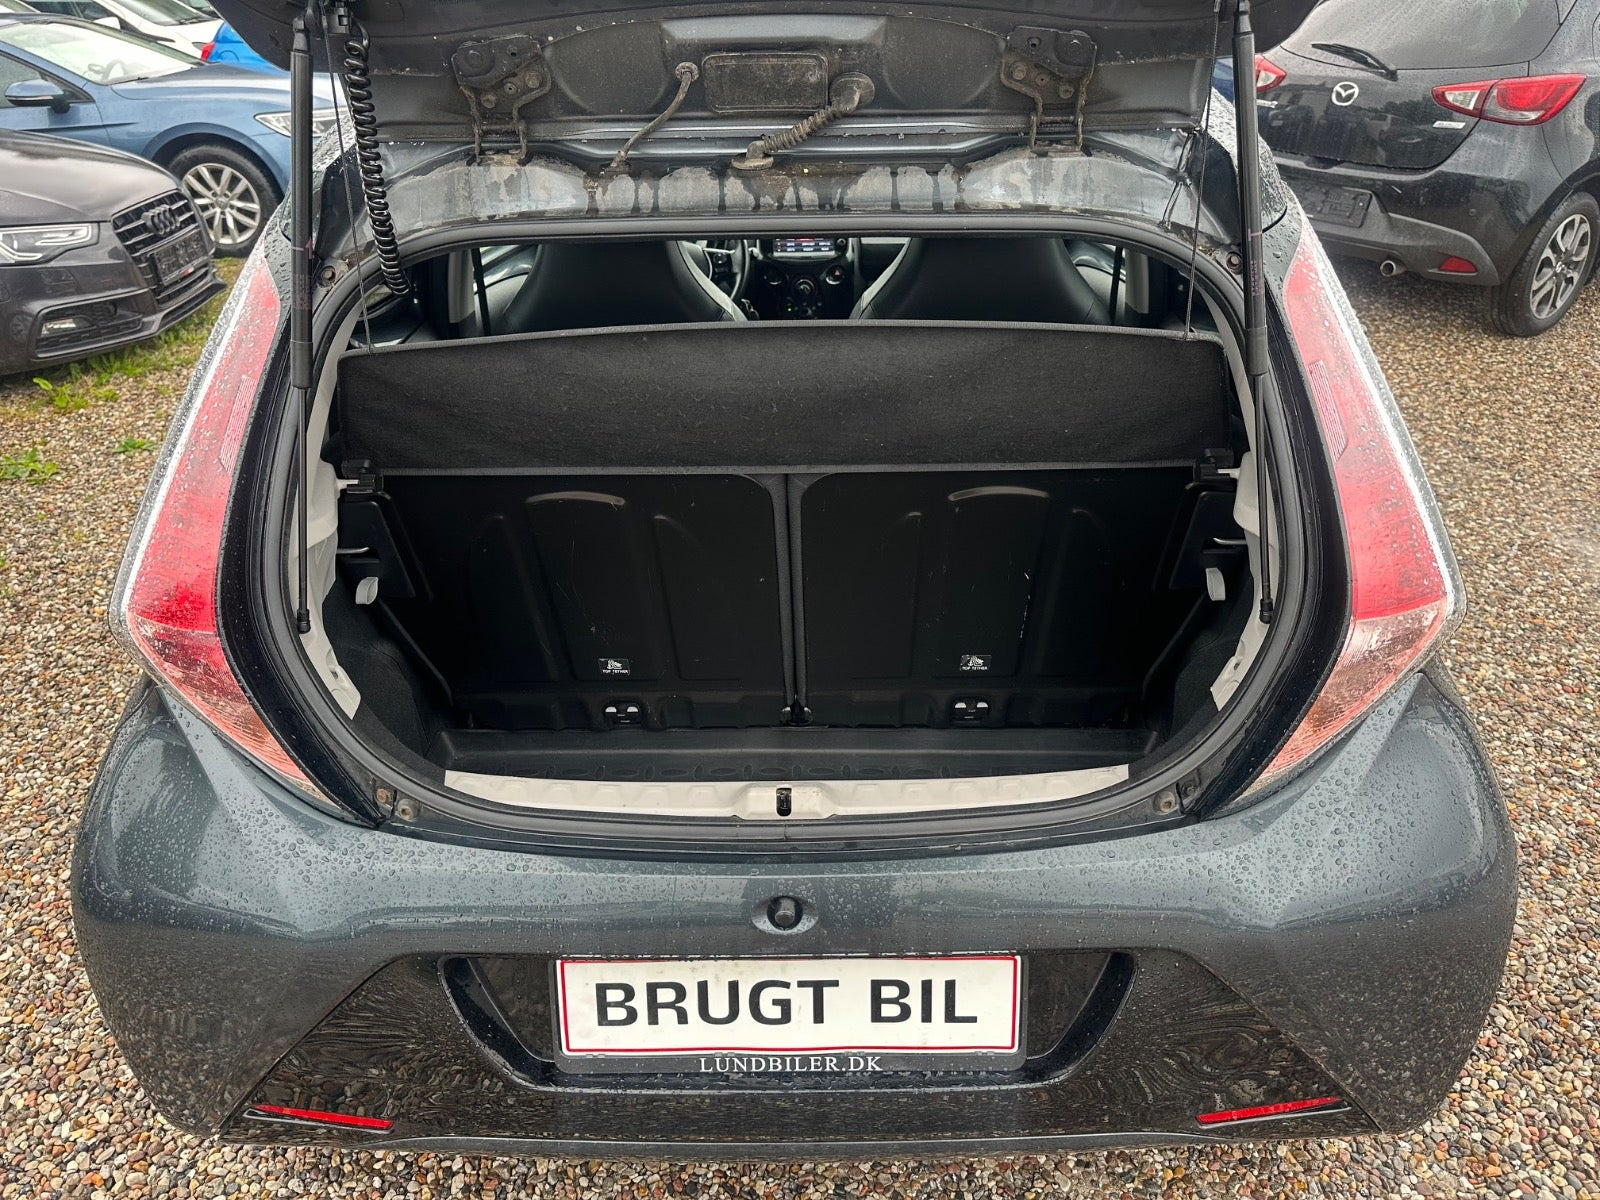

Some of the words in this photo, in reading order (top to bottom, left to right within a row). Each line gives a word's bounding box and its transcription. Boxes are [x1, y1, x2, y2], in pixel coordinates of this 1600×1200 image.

[595, 979, 839, 1027] BRUGT
[870, 979, 978, 1024] BIL
[700, 1056, 883, 1073] LUNDBILER.DK
